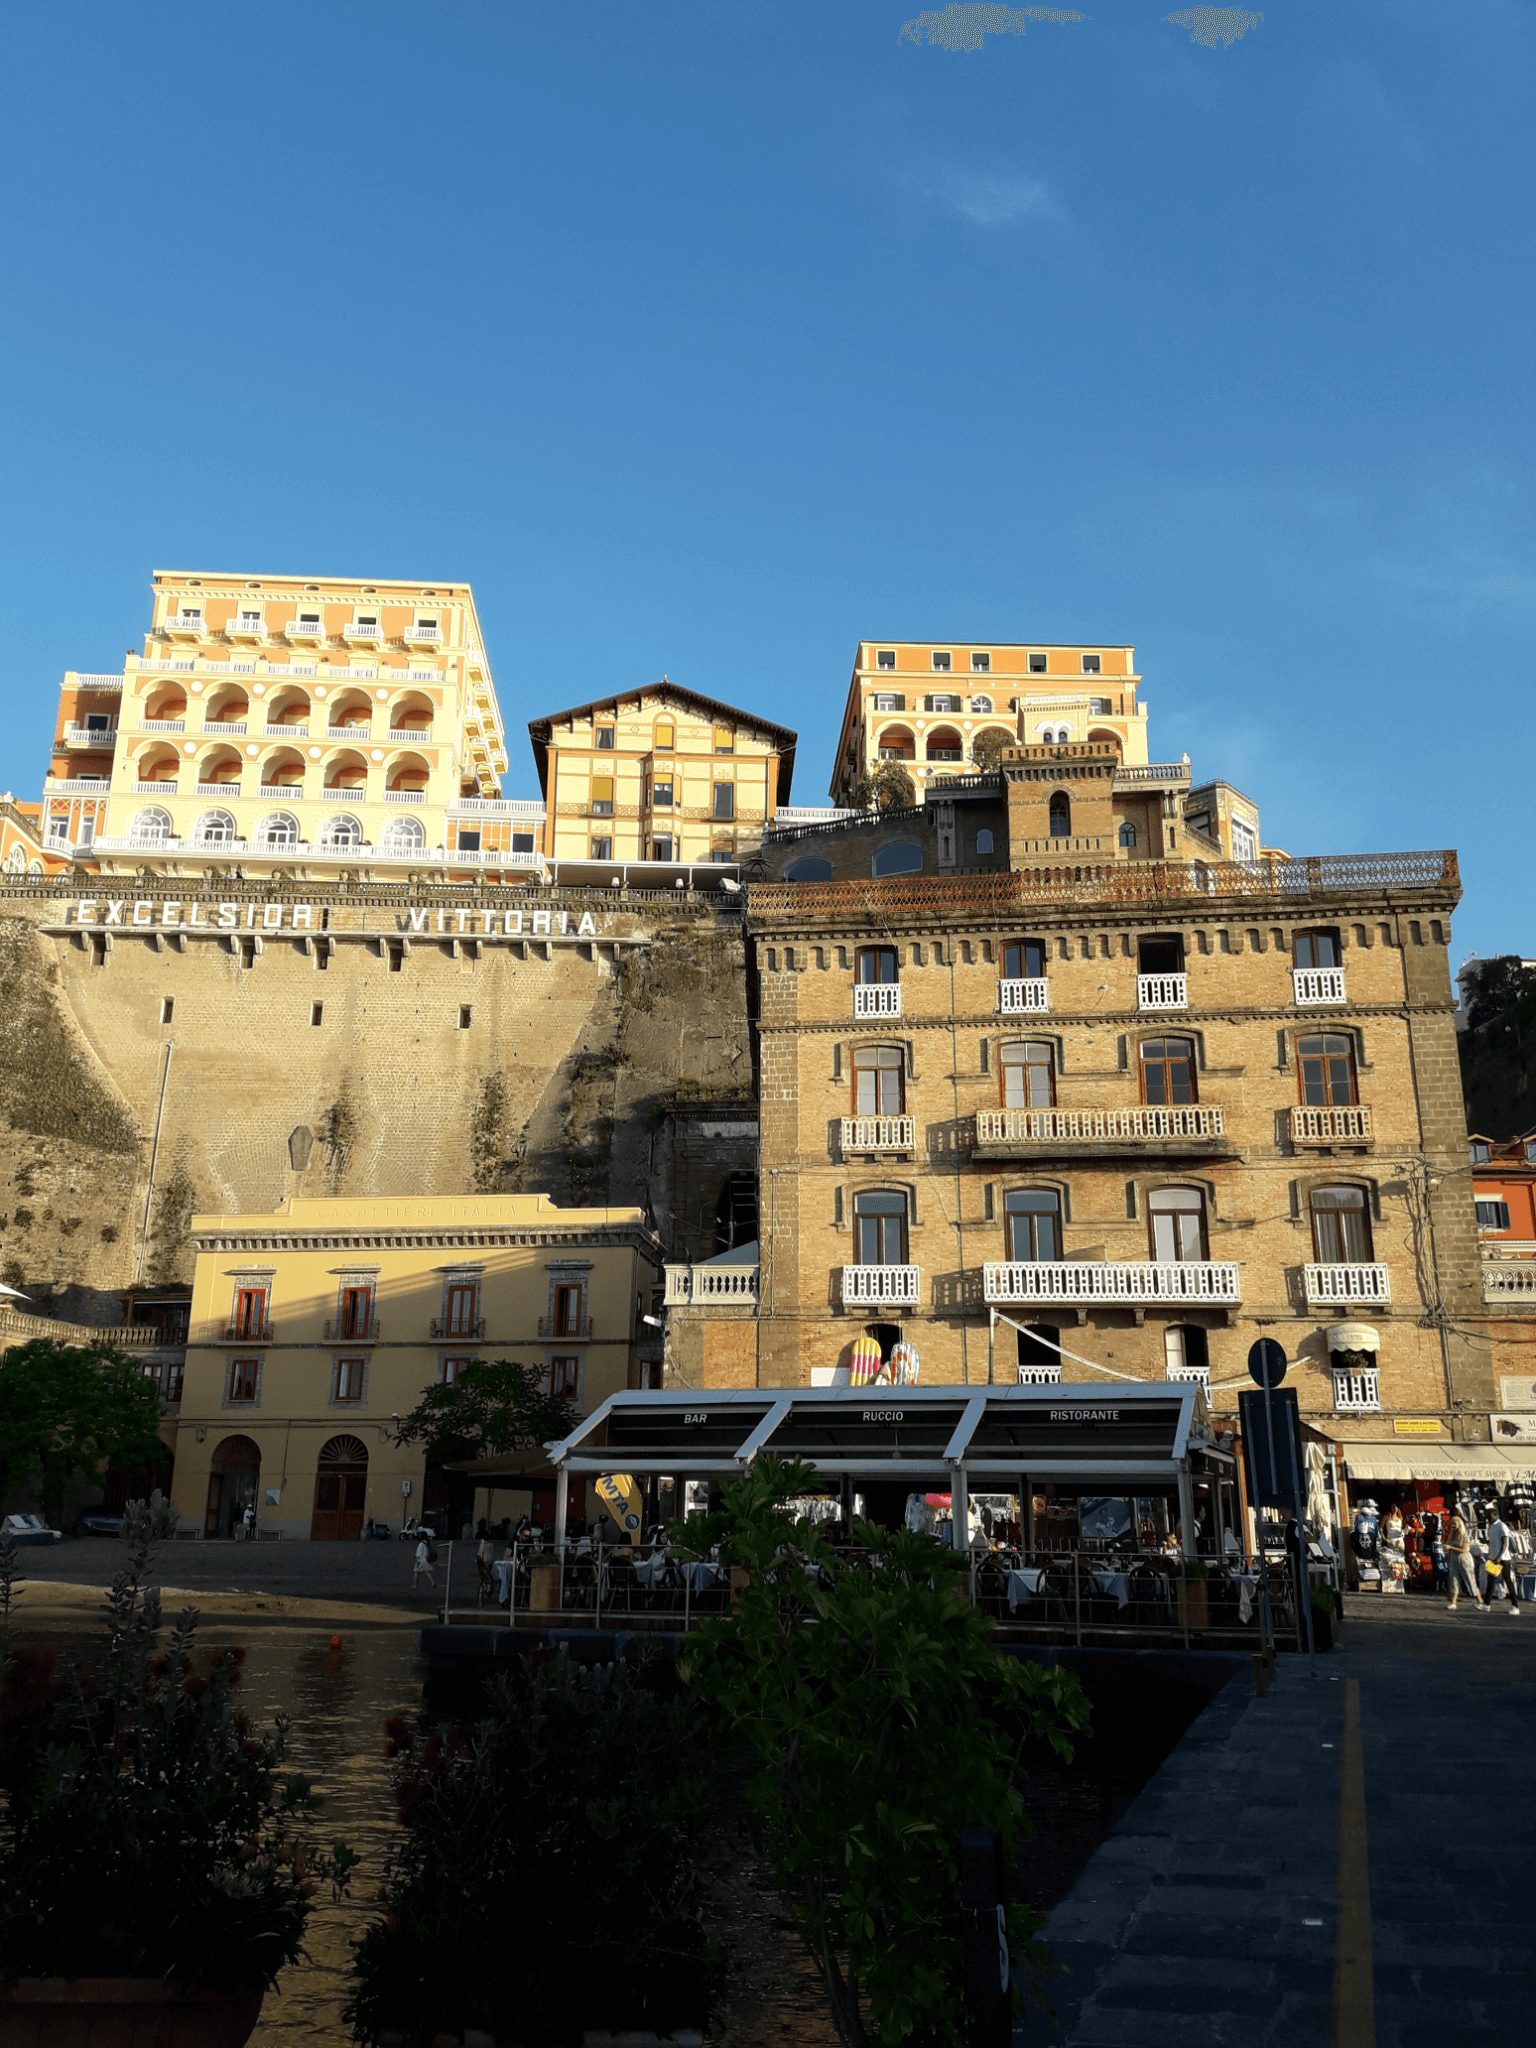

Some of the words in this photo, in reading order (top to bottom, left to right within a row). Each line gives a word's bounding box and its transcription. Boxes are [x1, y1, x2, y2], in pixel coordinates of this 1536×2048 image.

[77, 900, 312, 928] EXCELSIOR
[408, 907, 596, 935] VITTORIA
[316, 1206, 435, 1219] CANOTTIERI
[452, 1204, 516, 1217] ITALIA
[684, 1414, 707, 1424] BAR
[863, 1411, 903, 1421] RUCCIO
[1050, 1410, 1119, 1420] RISTORANTE
[1414, 1469, 1454, 1478] SOUVENIR
[1456, 1470, 1462, 1478] &
[1464, 1470, 1482, 1478] GIFT
[1485, 1470, 1506, 1478] SHOP
